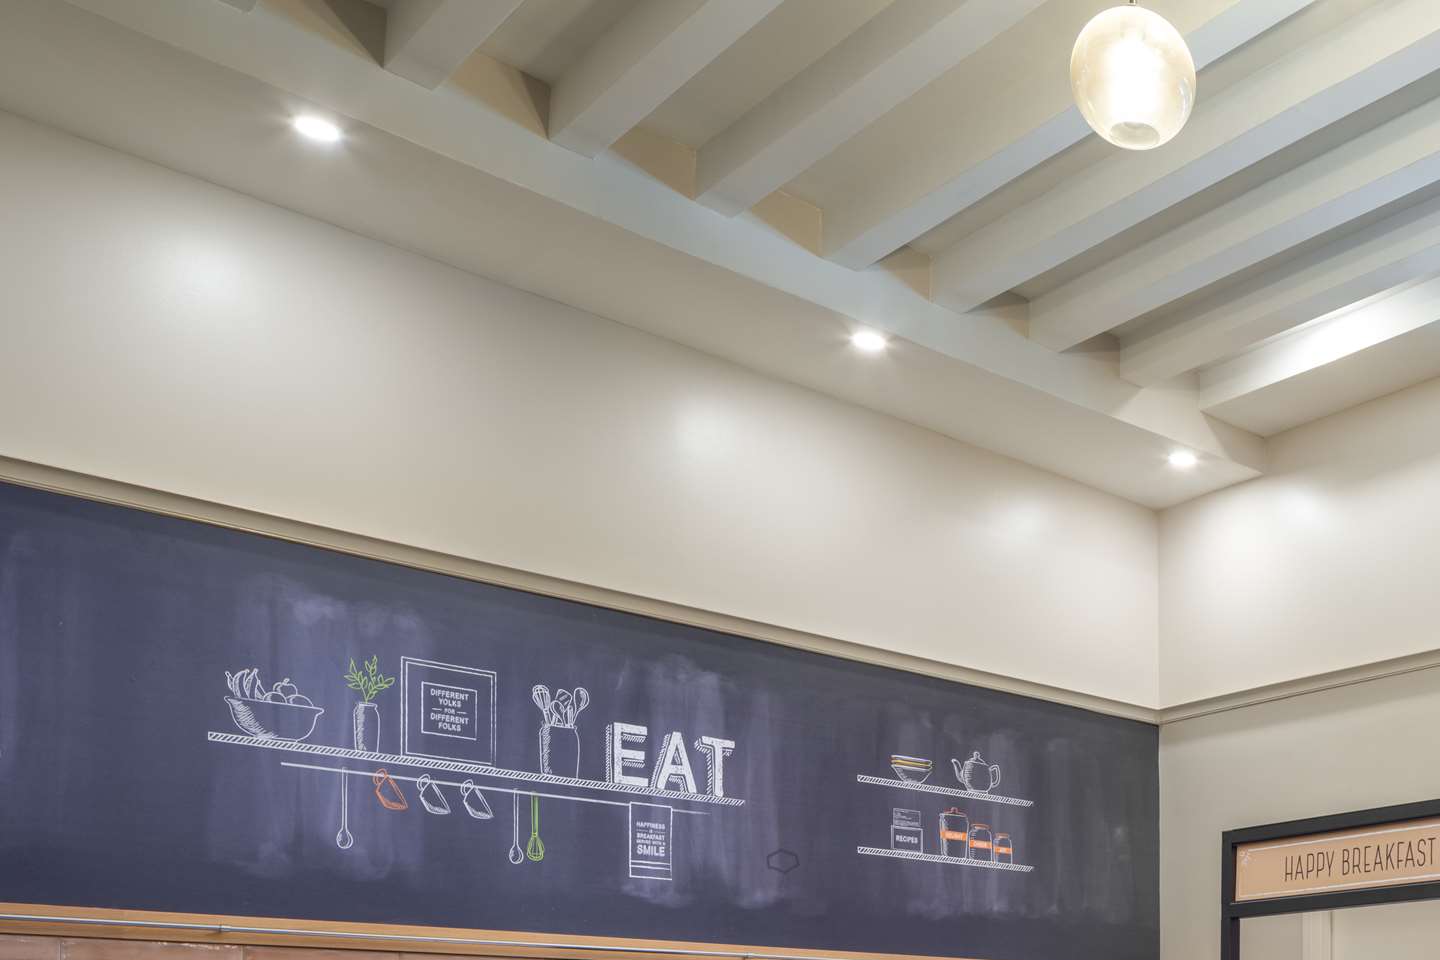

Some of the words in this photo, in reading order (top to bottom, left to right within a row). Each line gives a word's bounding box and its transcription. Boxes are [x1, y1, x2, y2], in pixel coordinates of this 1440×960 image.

[430, 688, 470, 700] DIFFERENT
[438, 697, 462, 708] YOLKS
[430, 712, 470, 725] DIFFERENT
[438, 722, 462, 732] FOLKS
[605, 721, 736, 798] EAT
[636, 844, 665, 857] SMILE
[1284, 850, 1335, 882] HAPPY
[1342, 837, 1437, 876] BREAKFAST
